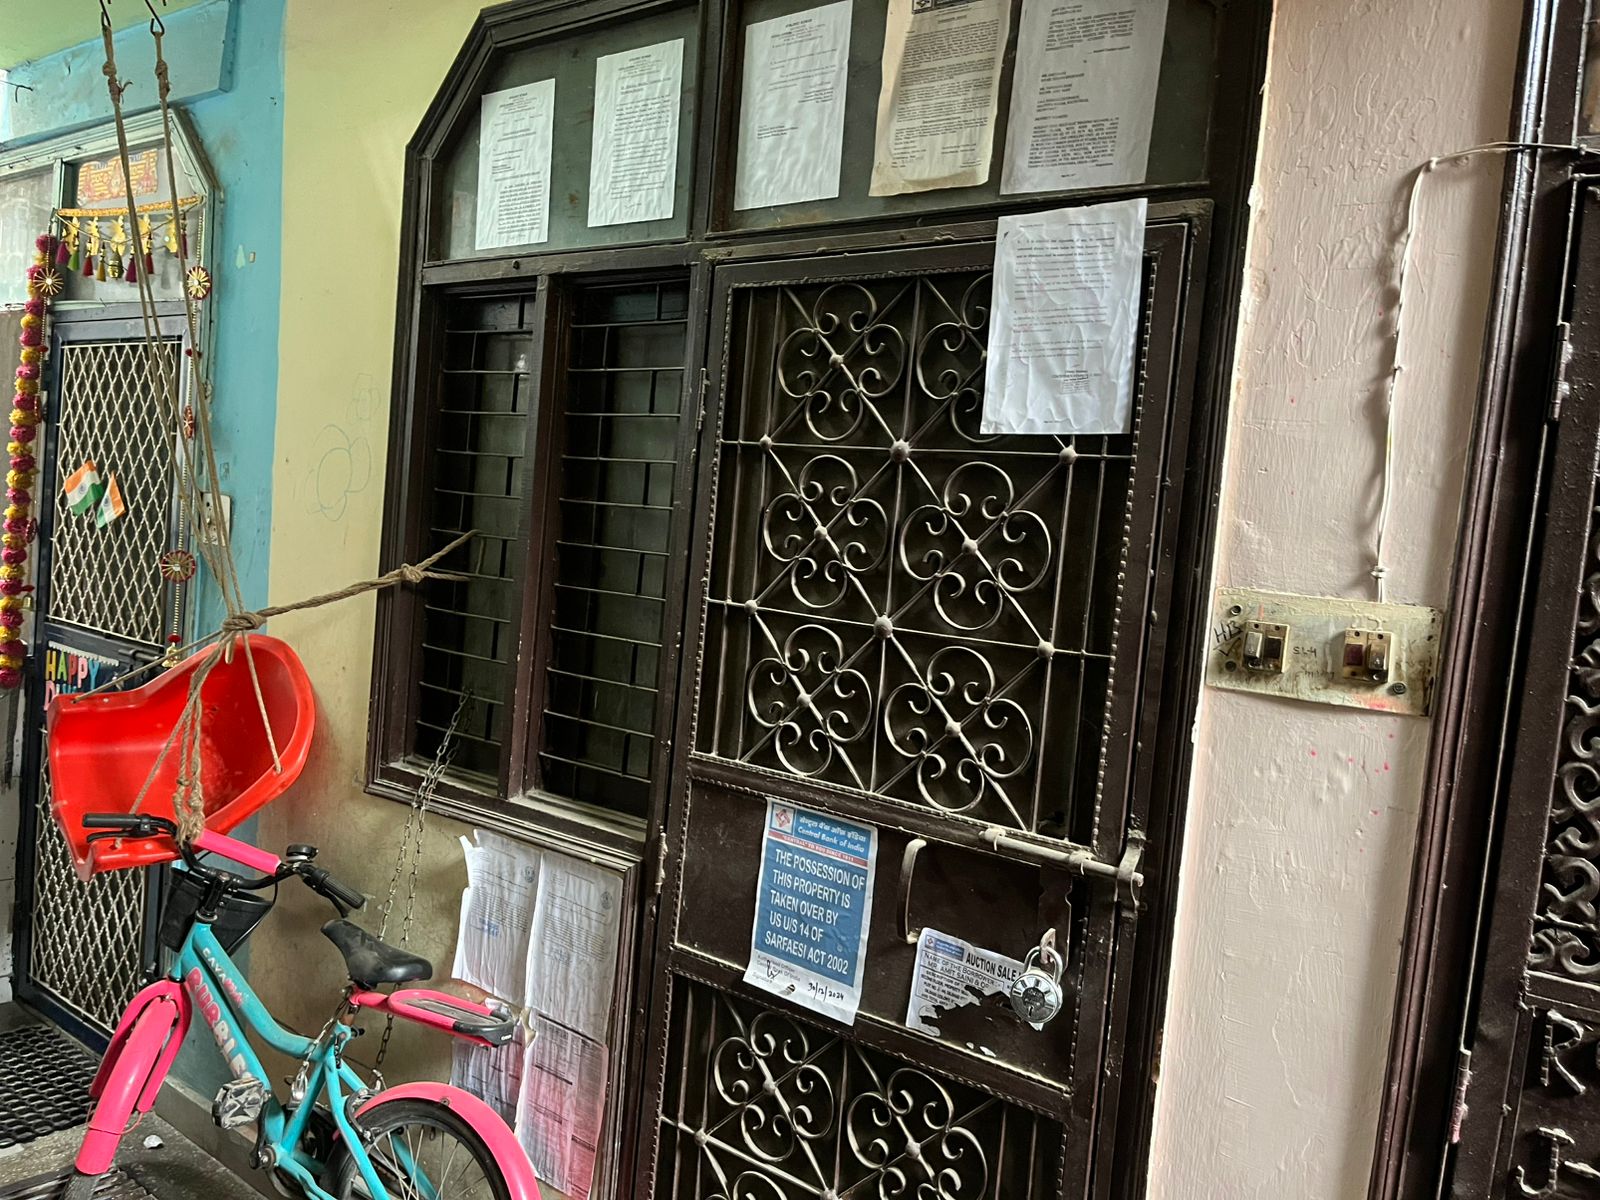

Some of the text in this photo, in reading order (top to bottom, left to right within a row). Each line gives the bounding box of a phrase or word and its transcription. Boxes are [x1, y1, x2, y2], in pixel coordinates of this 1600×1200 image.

[45, 649, 100, 690] HAPPY
[798, 826, 864, 853] Central Bank of India
[776, 848, 866, 890] THE POSSESSION OF
[773, 869, 851, 908] THIS PROPERTY IS
[770, 890, 838, 926] TAKEN OVER BY
[770, 910, 824, 942] US U/S 14 OF
[765, 930, 849, 974] SARFAESI ACT 2002
[924, 952, 940, 963] NAME
[950, 962, 961, 972] THE
[966, 952, 1016, 982] AUCTION SALE
[940, 966, 955, 976] AMIT
[957, 973, 974, 984] SAINI
